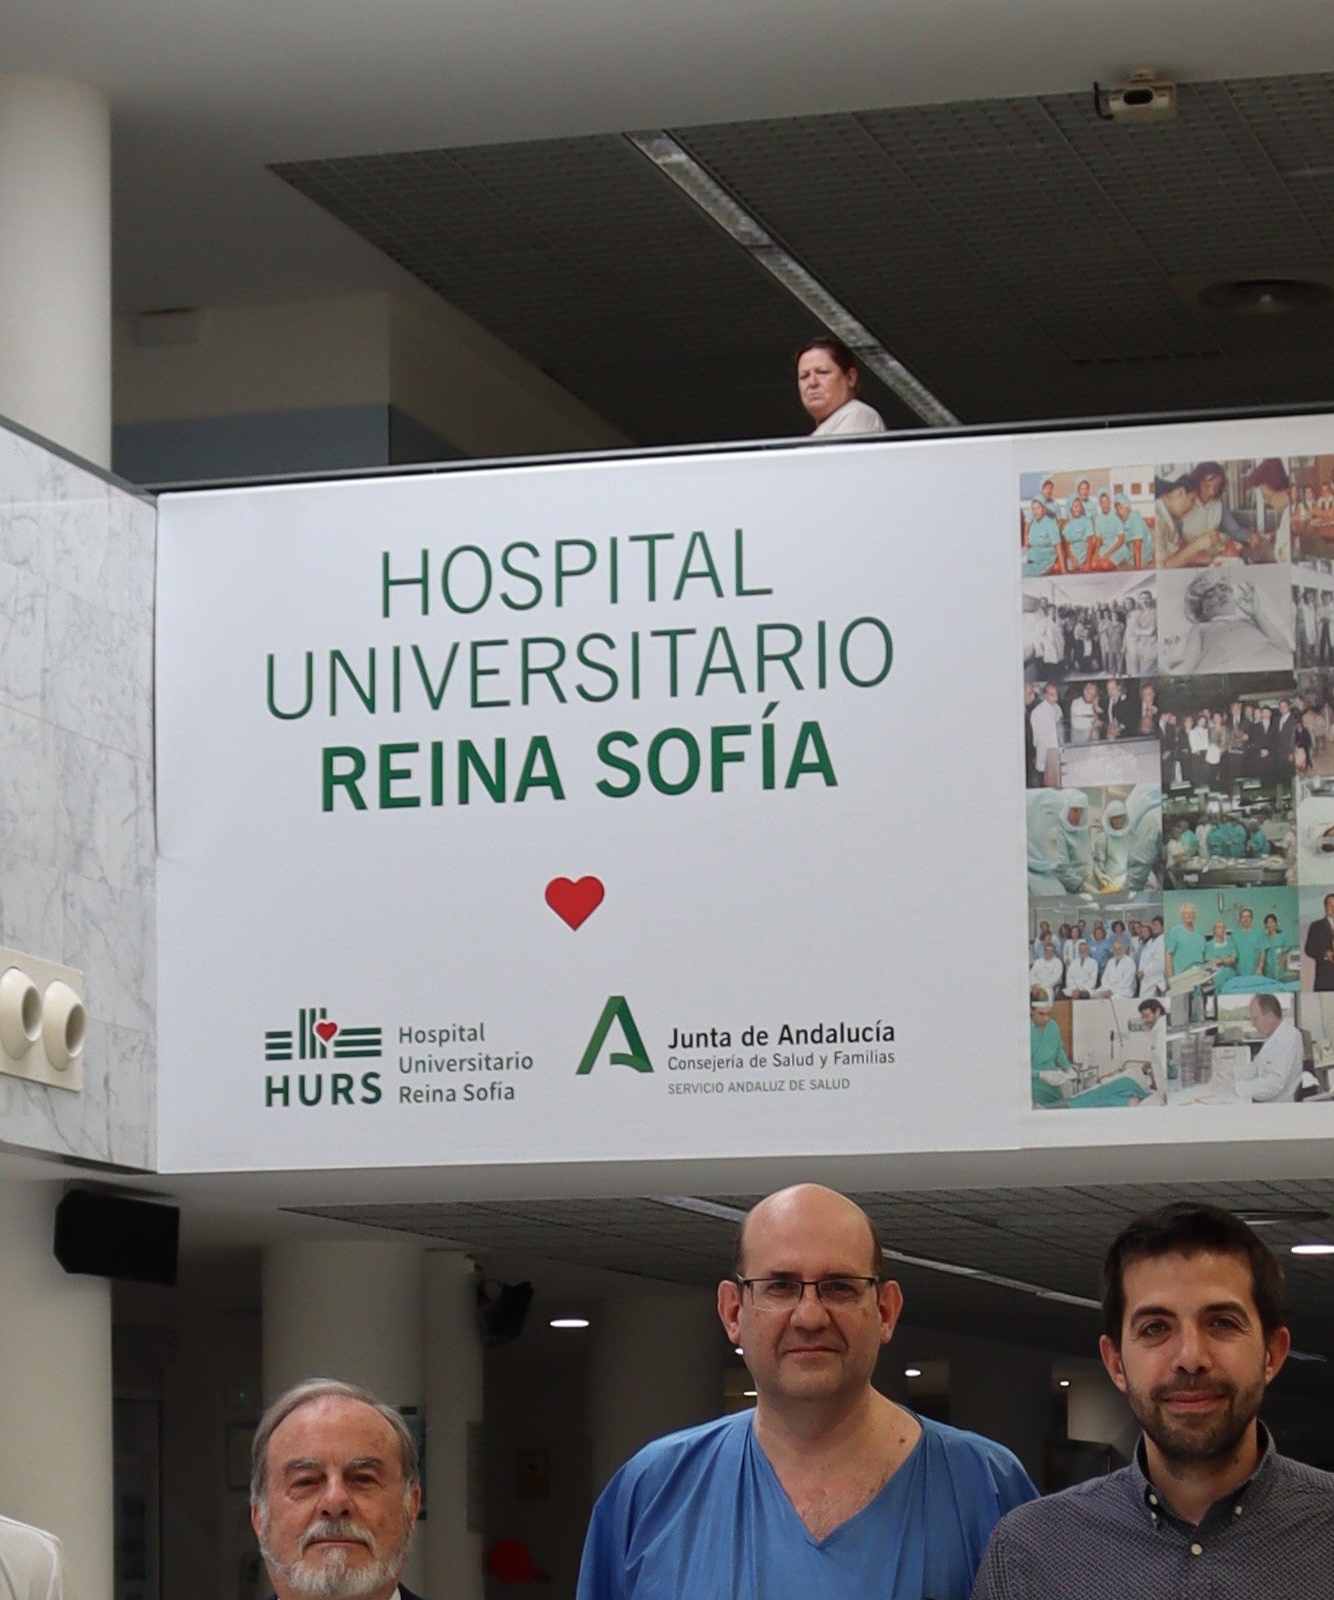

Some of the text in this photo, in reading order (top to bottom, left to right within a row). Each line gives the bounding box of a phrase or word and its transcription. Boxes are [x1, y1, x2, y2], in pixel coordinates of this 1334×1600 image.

[382, 528, 774, 618] HOSPITAL
[266, 616, 895, 720] UNIVERSITARIO
[321, 701, 839, 812] REINA SOFÍA
[398, 1023, 486, 1047] Hospital
[668, 1019, 896, 1049] Junta de Andalucía
[398, 1052, 534, 1074] Universitario
[667, 1049, 896, 1073] Consejería de Salud y Familias
[265, 1072, 383, 1107] HURS
[398, 1081, 516, 1104] Reina Sofía
[667, 1078, 851, 1096] SERVICIO ANDALUZ DE SALUD
